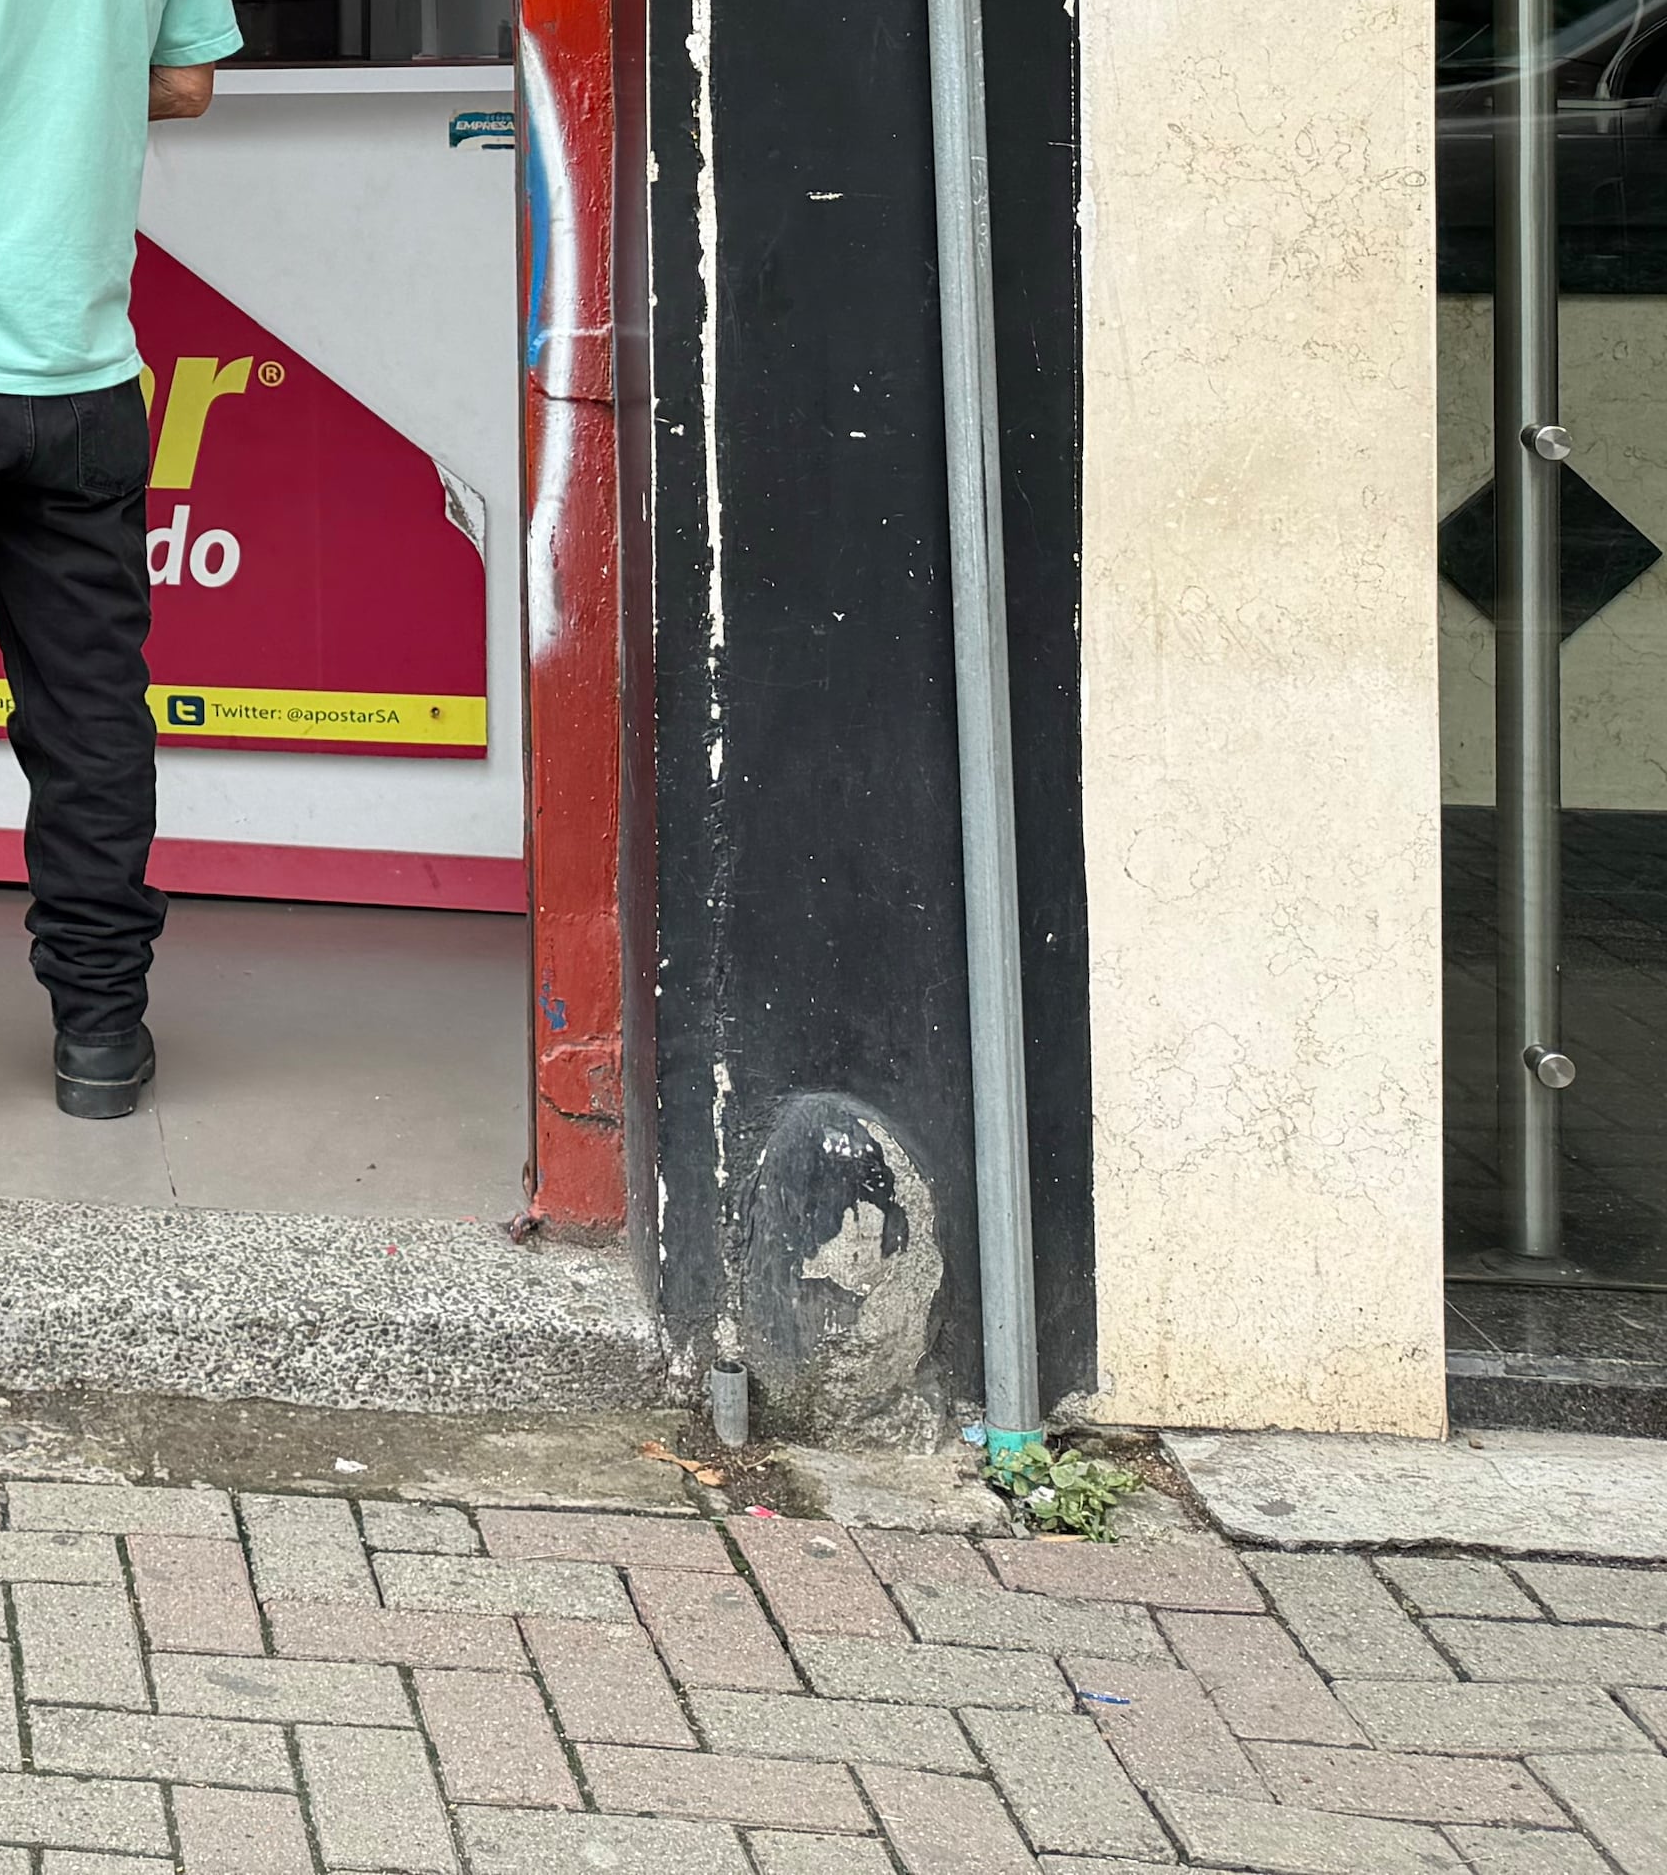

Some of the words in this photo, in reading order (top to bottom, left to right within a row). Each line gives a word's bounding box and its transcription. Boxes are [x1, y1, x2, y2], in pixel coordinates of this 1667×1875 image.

[455, 121, 515, 131] EMPRESA
[211, 703, 282, 720] Twitter:
[286, 708, 400, 724] @apostarSA
